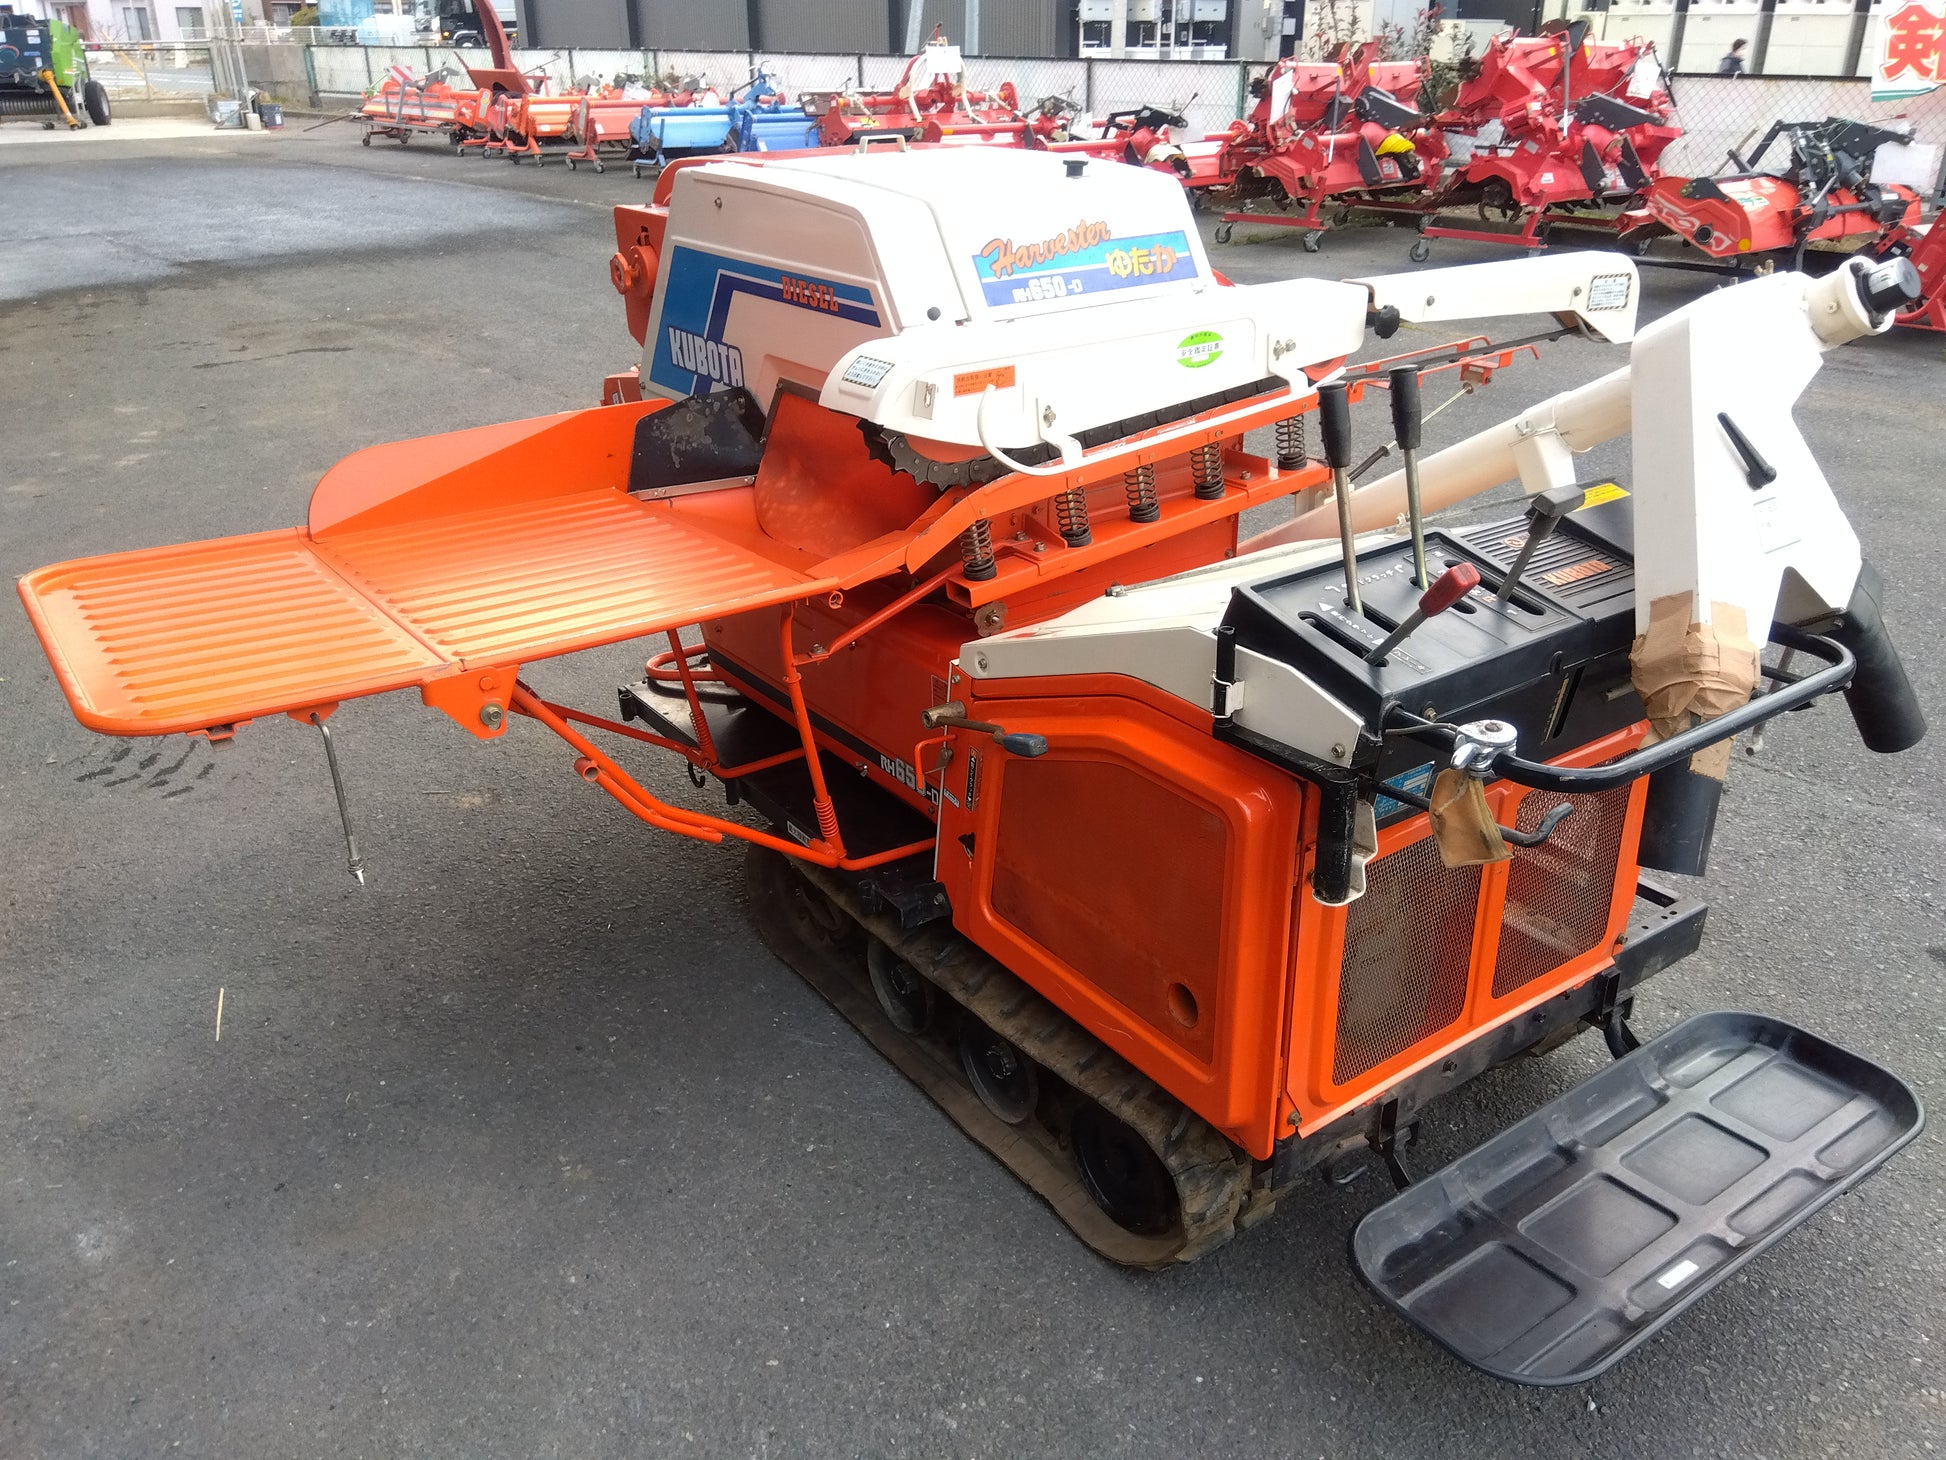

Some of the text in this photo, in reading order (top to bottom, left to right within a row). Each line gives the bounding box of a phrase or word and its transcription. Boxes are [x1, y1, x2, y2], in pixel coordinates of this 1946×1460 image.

[978, 219, 1111, 279] Harvester
[1105, 243, 1178, 278] ゆたか
[780, 275, 839, 312] DIESEL
[668, 326, 744, 387] KUBOTA
[1541, 559, 1613, 587] KUBOTA
